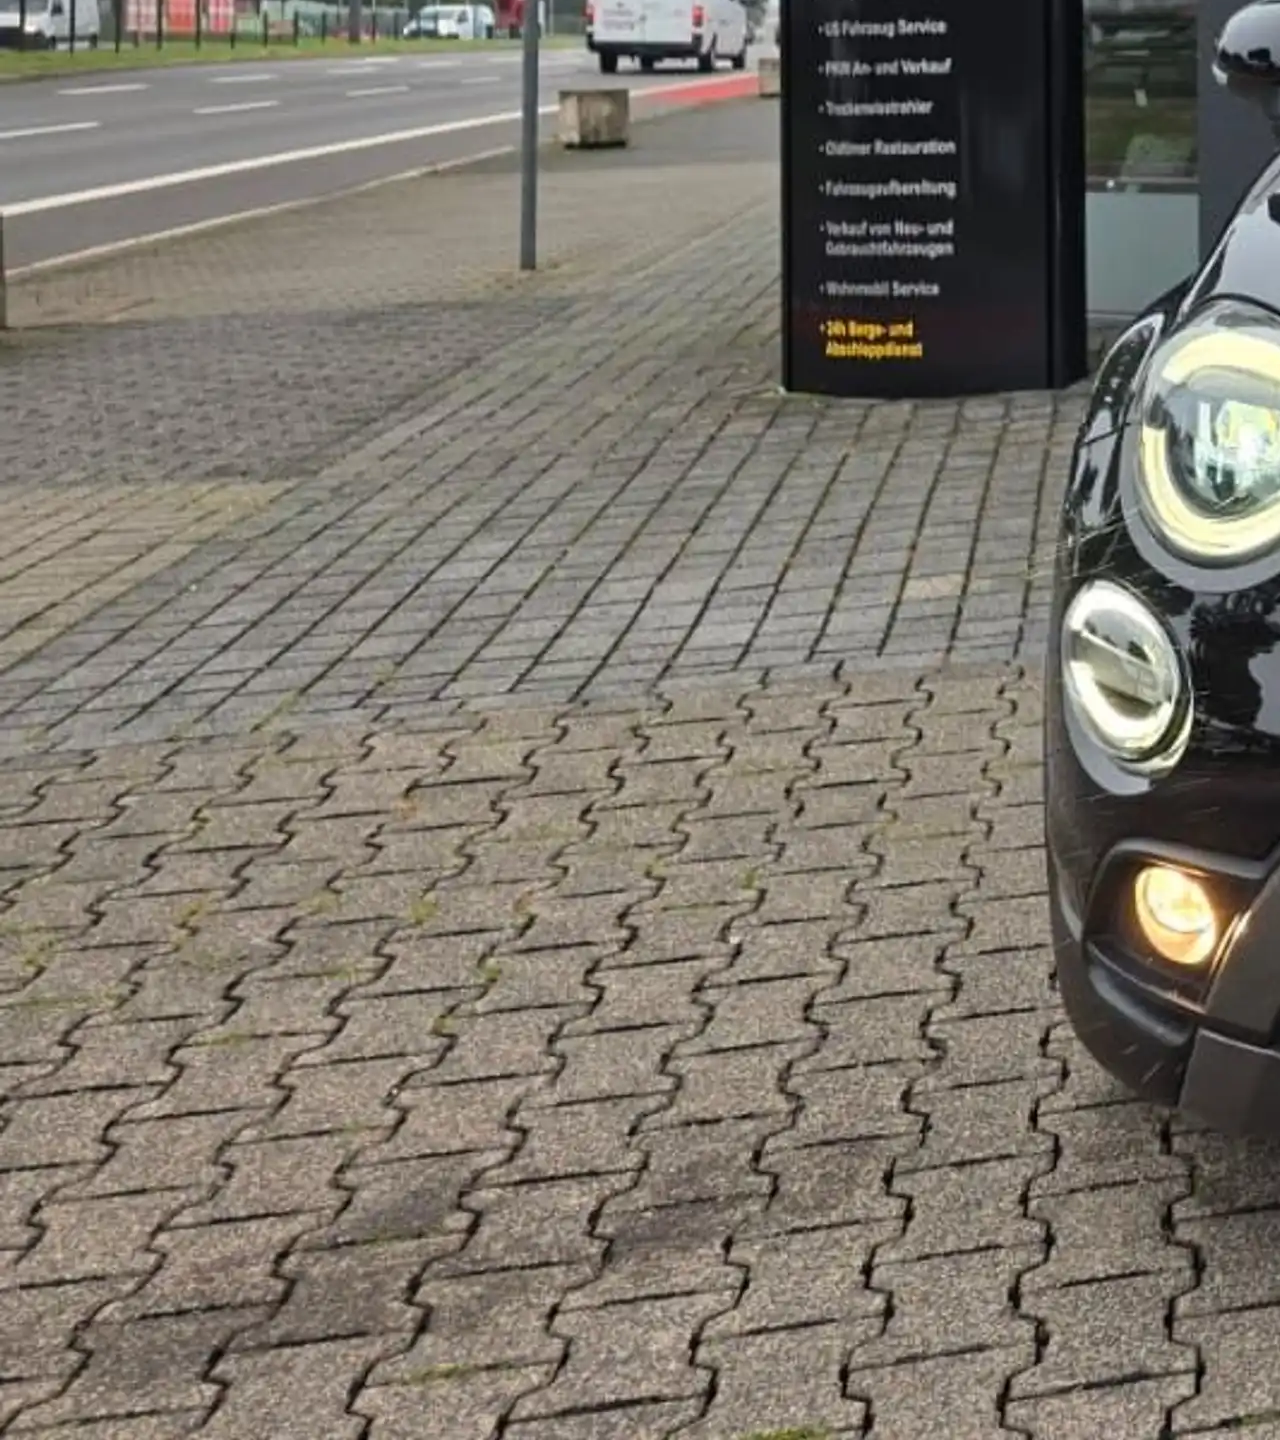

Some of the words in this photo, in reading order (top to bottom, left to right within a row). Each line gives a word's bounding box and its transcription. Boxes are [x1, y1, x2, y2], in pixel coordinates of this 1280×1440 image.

[897, 17, 948, 34] Service
[900, 57, 952, 74] Verkauf
[892, 280, 941, 297] Service
